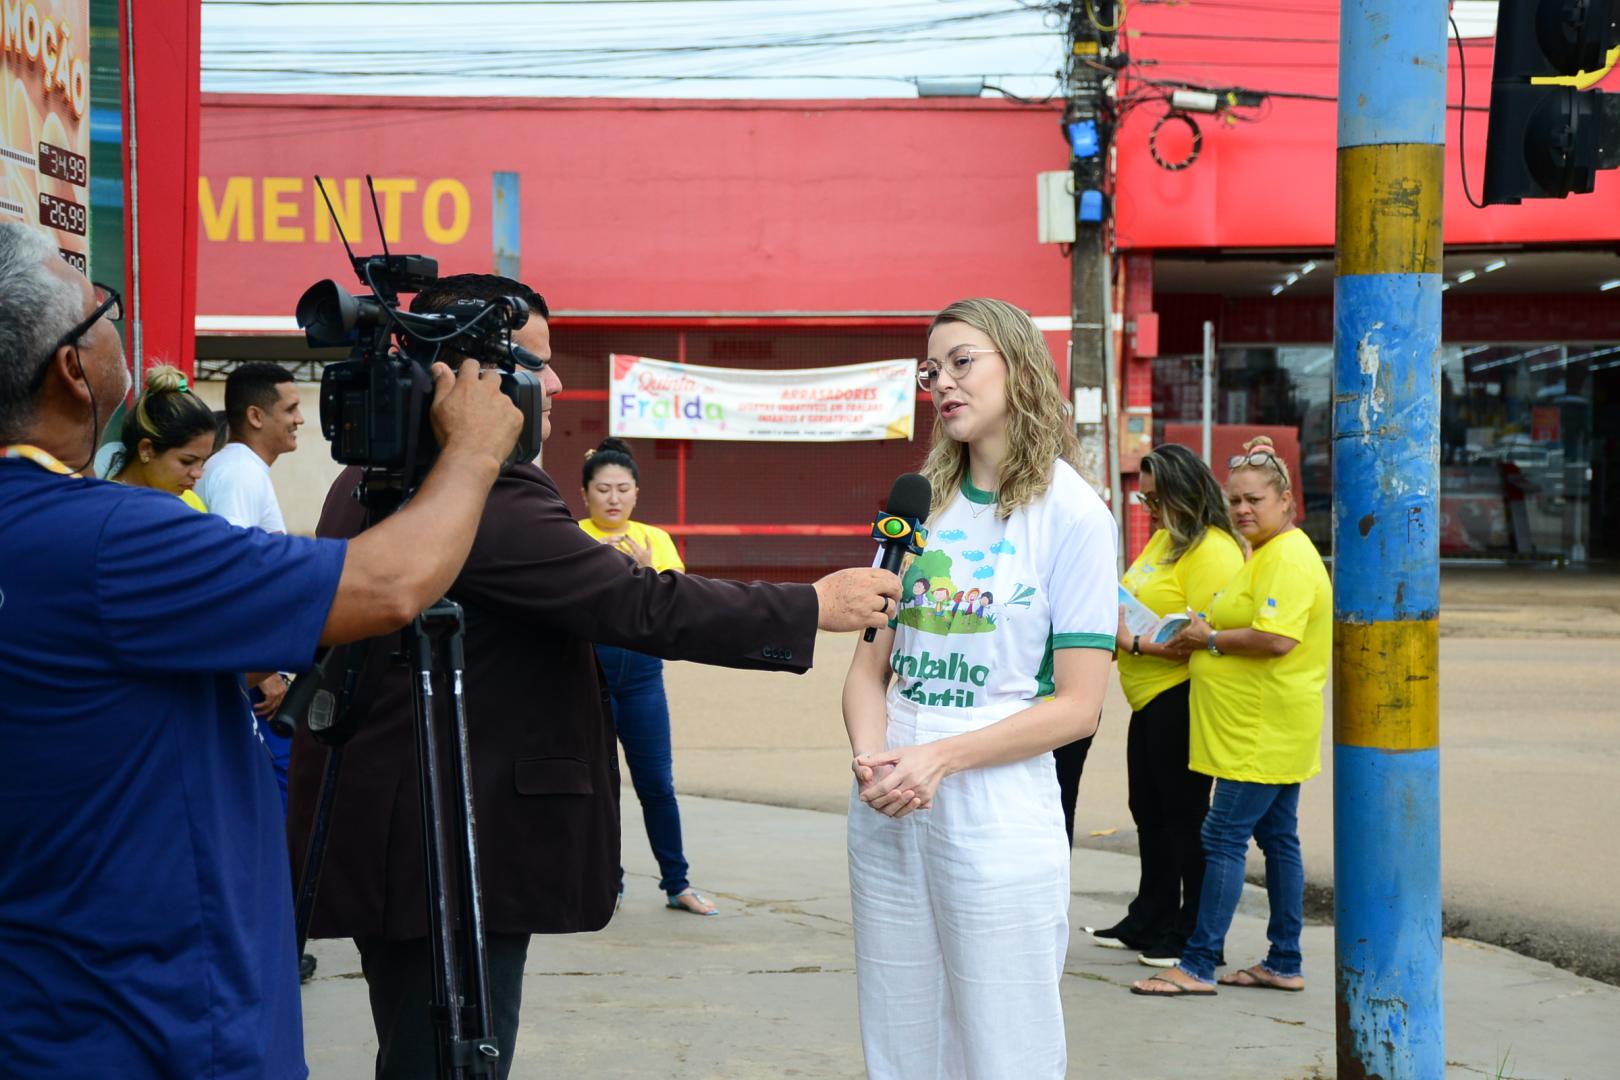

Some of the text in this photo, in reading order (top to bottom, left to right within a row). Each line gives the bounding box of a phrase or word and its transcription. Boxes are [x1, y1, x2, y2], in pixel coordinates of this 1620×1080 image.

[0, 0, 86, 115] MOÇÃO
[50, 150, 86, 182] 34,99
[50, 200, 86, 232] 26,99
[198, 175, 472, 246] MENTO
[620, 392, 725, 421] Fralda
[781, 387, 880, 401] ARRASADORES
